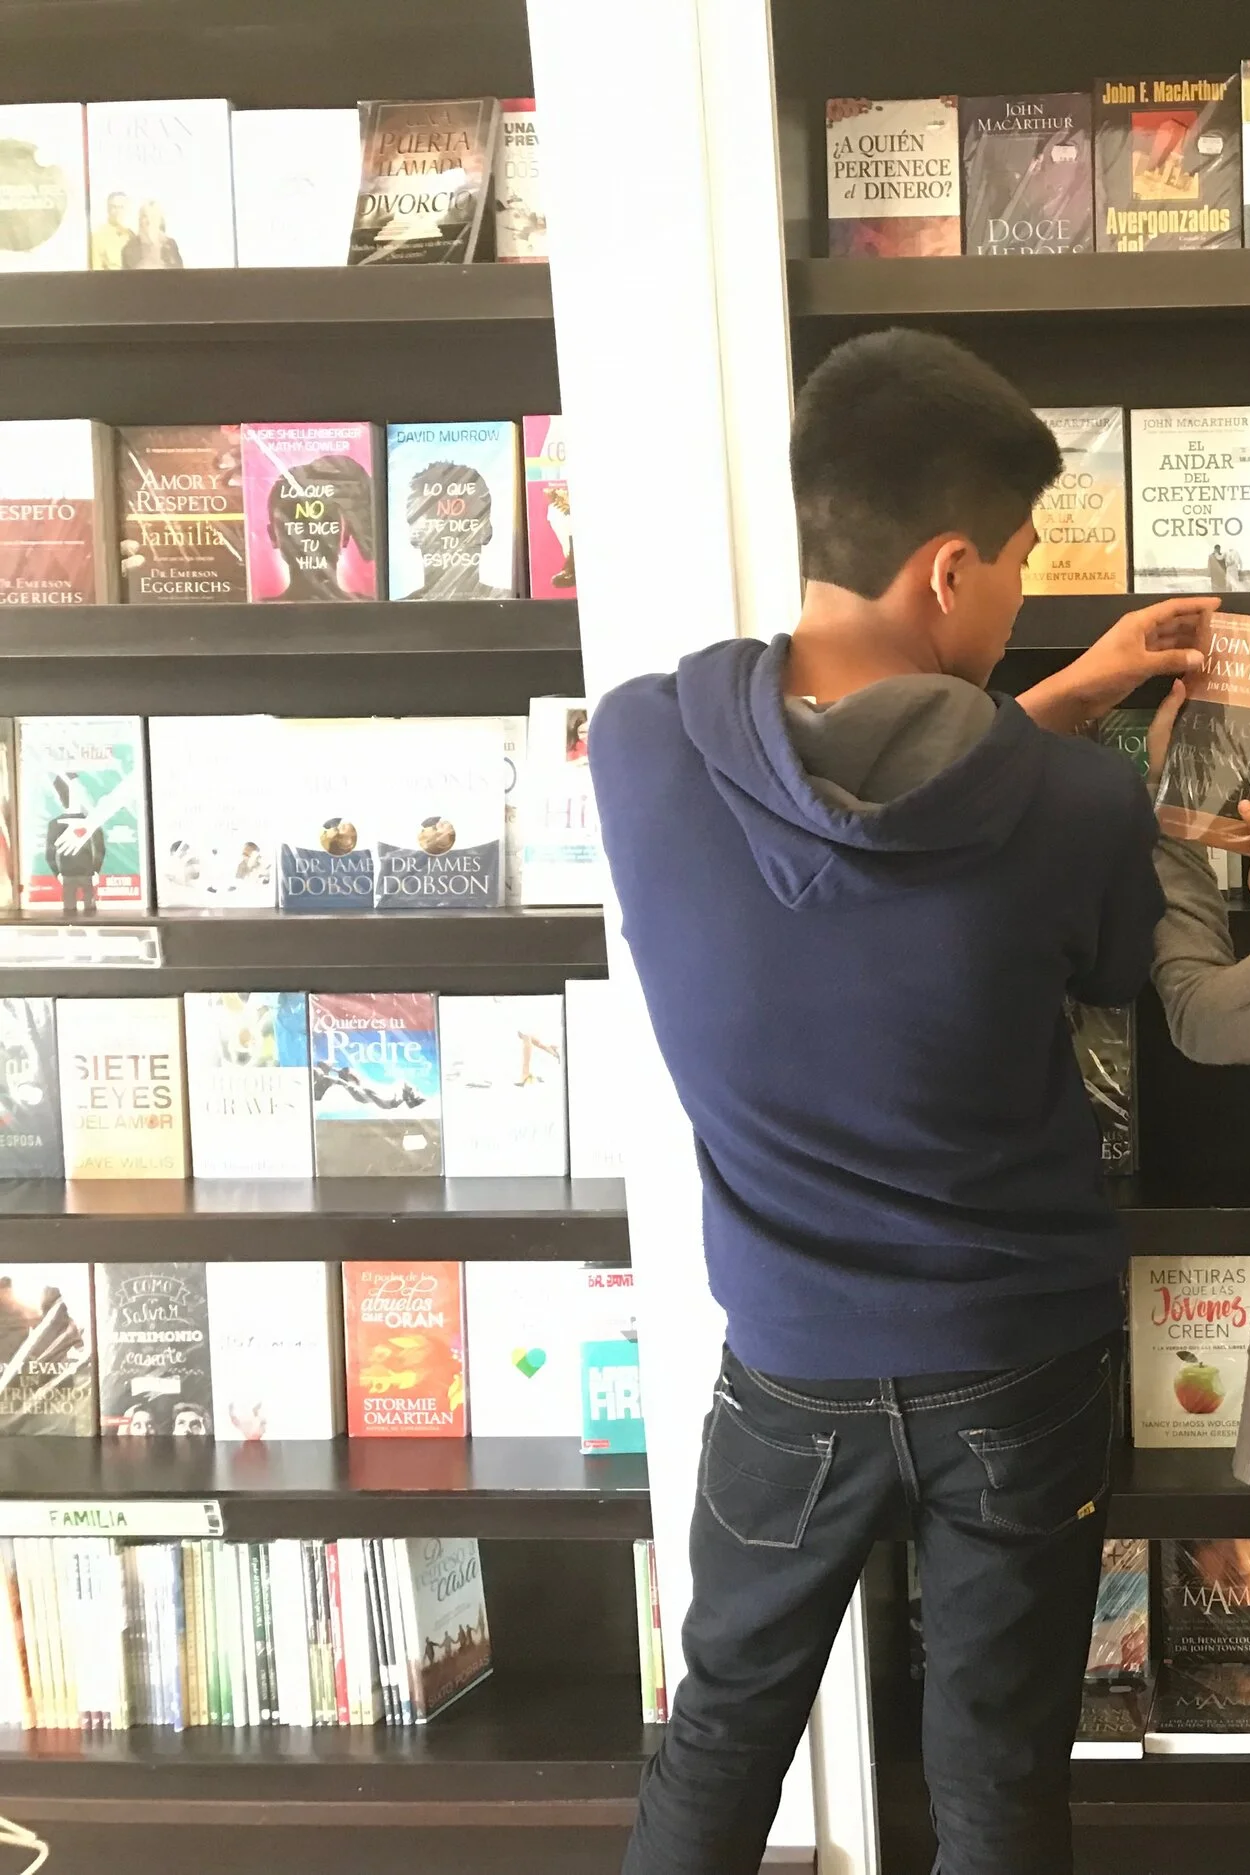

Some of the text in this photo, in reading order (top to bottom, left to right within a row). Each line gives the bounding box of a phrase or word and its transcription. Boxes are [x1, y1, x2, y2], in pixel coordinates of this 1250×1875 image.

[1101, 81, 1136, 104] John
[1153, 76, 1228, 102] MacArthur
[1005, 103, 1045, 117] JOHN
[504, 122, 536, 134] UNA
[379, 131, 470, 154] PUERTA
[859, 129, 925, 156] QUIÉN
[833, 158, 952, 178] PERTENECE
[843, 181, 954, 201] el DINERO?
[360, 190, 474, 217] DIVORCIO
[1106, 204, 1232, 238] Avergonzados
[987, 218, 1072, 243] DOCE
[1143, 415, 1250, 432] JOHN MACARTHUR
[396, 429, 500, 444] DAVID MURROW
[1187, 440, 1205, 452] EL
[1158, 453, 1235, 471] ANDAR
[141, 470, 220, 491] AMOR Y
[1183, 472, 1210, 484] DEL
[305, 484, 335, 499] QUE
[422, 482, 477, 497] LO QUE
[135, 490, 228, 512] RESPETO
[295, 500, 325, 520] NO
[436, 499, 466, 518] NO
[1181, 504, 1213, 516] CON
[284, 520, 341, 535] TE DICE
[425, 518, 479, 532] TE DICE
[1151, 516, 1244, 538] CRISTO
[300, 538, 321, 553] TU
[440, 535, 460, 550] TU
[422, 552, 481, 569] ESPOSO
[140, 577, 231, 594] EGGERICHS
[1208, 632, 1250, 658] JOHN
[1206, 681, 1220, 692] JIM
[390, 855, 481, 876] DR JAMES
[382, 874, 491, 896] DOBSON
[325, 1029, 422, 1063] Padre
[72, 1053, 171, 1081] SIETE
[1149, 1268, 1247, 1285] MENTIRAS
[1180, 1284, 1235, 1298] QUE LAS
[1150, 1286, 1248, 1328] Jóvenes
[384, 1311, 445, 1329] ORAN
[1167, 1323, 1230, 1340] CREEN
[363, 1397, 437, 1412] STORMIE
[364, 1411, 455, 1426] OMARTIAN
[48, 1509, 129, 1531] FAMILIA
